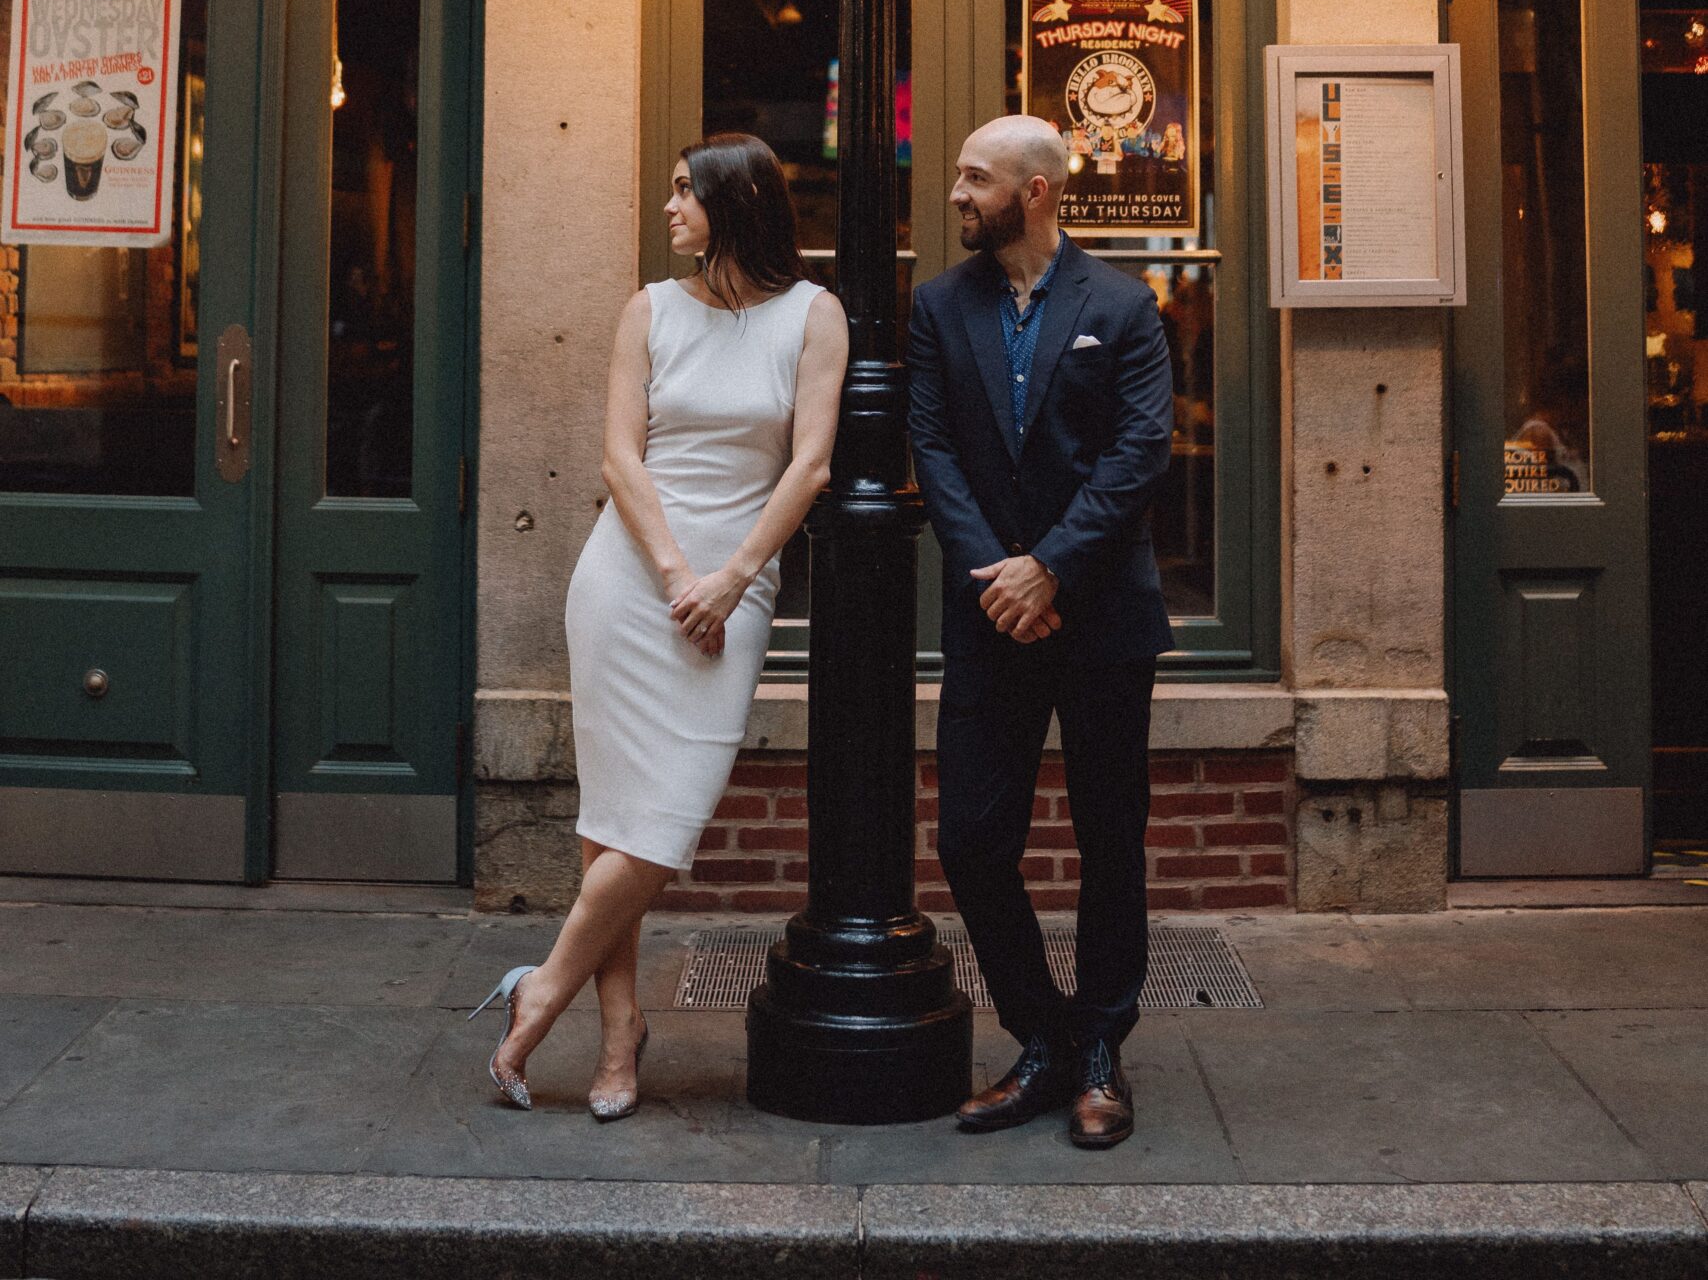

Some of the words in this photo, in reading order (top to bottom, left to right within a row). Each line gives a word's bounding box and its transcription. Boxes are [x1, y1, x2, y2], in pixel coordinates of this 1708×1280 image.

[28, 19, 159, 60] OYSTER
[1036, 21, 1126, 49] THURSDAY
[1128, 22, 1185, 49] NIGHT
[1080, 39, 1141, 49] RESIDENCY
[1069, 57, 1099, 92] HELLO
[1102, 53, 1152, 92] BROOKLYN
[1087, 194, 1126, 202] 11:30PM
[1135, 194, 1148, 202] NO
[1151, 194, 1181, 202] COVER
[1096, 205, 1182, 217] THURSDAY
